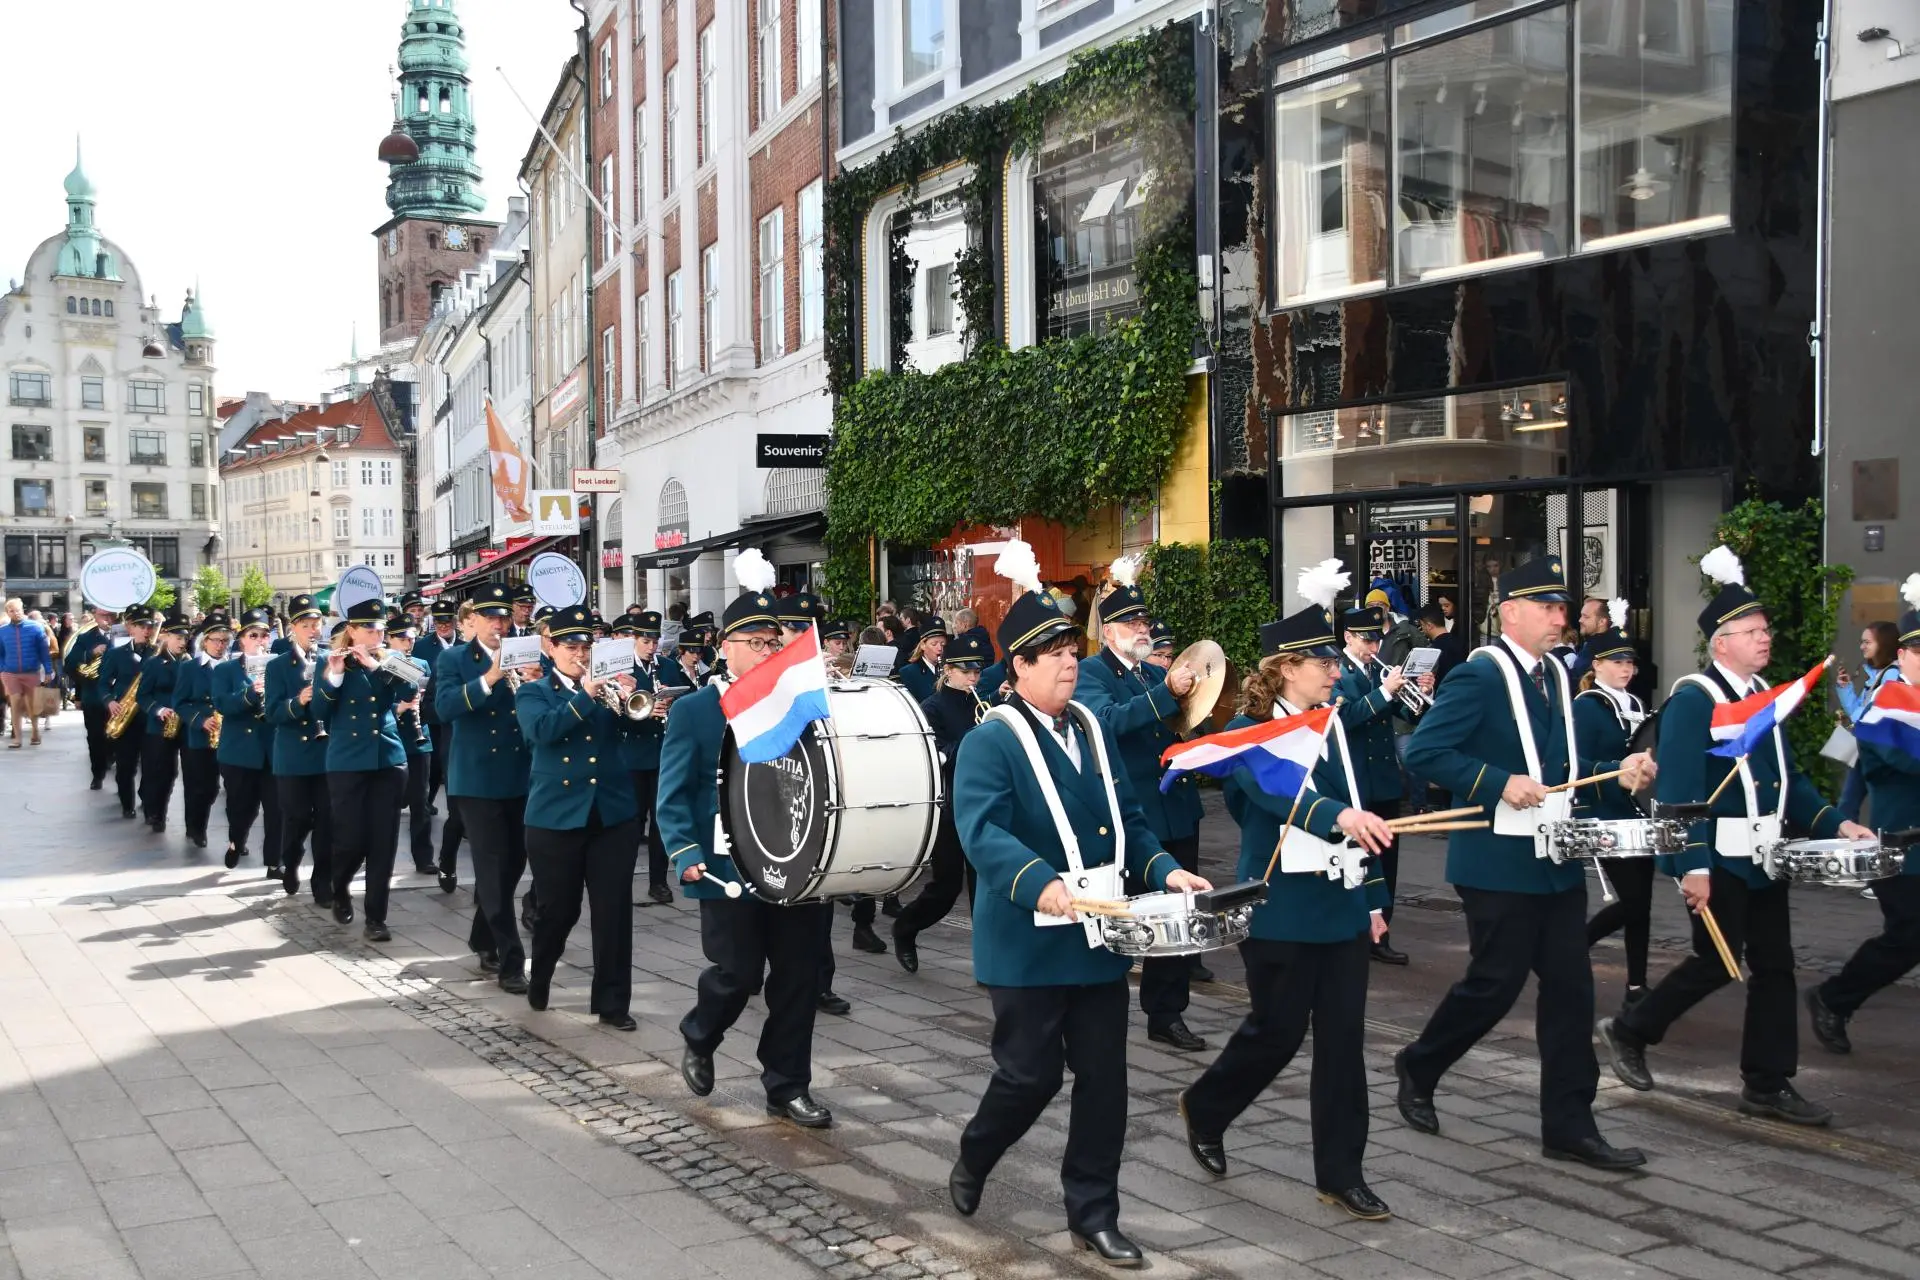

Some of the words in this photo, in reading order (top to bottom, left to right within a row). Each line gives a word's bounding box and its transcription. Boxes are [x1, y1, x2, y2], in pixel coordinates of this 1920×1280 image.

[764, 444, 823, 457] Souvenirs
[91, 562, 139, 575] AMICITIA
[535, 565, 570, 577] AMICITIA
[346, 575, 378, 592] AMICITIA
[766, 873, 784, 886] REMO
